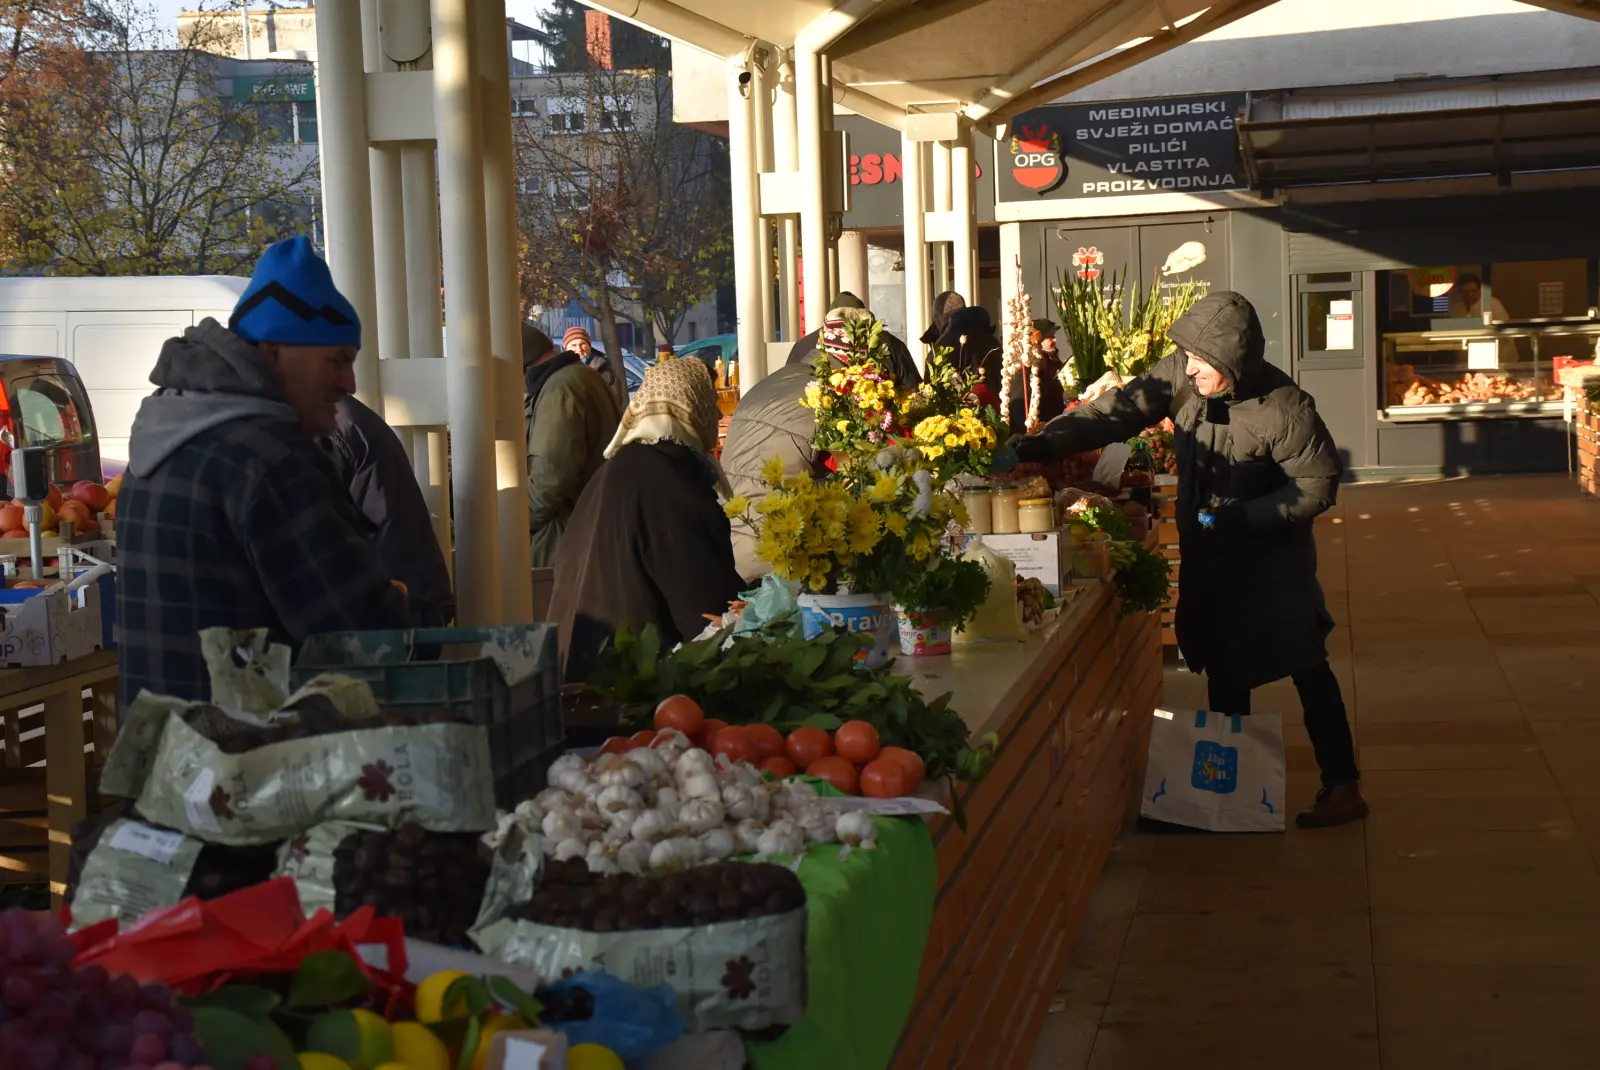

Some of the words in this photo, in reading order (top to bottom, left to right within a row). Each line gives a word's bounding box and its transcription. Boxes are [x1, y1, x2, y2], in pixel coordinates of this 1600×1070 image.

[1089, 101, 1226, 121] MEĐIMURSKI
[1076, 121, 1148, 140] SVJEŽI
[1128, 138, 1187, 155] PILIĆI
[1014, 152, 1055, 168] OPG
[1107, 157, 1210, 174] VLASTITA
[1083, 173, 1236, 194] PROIZVODNJA
